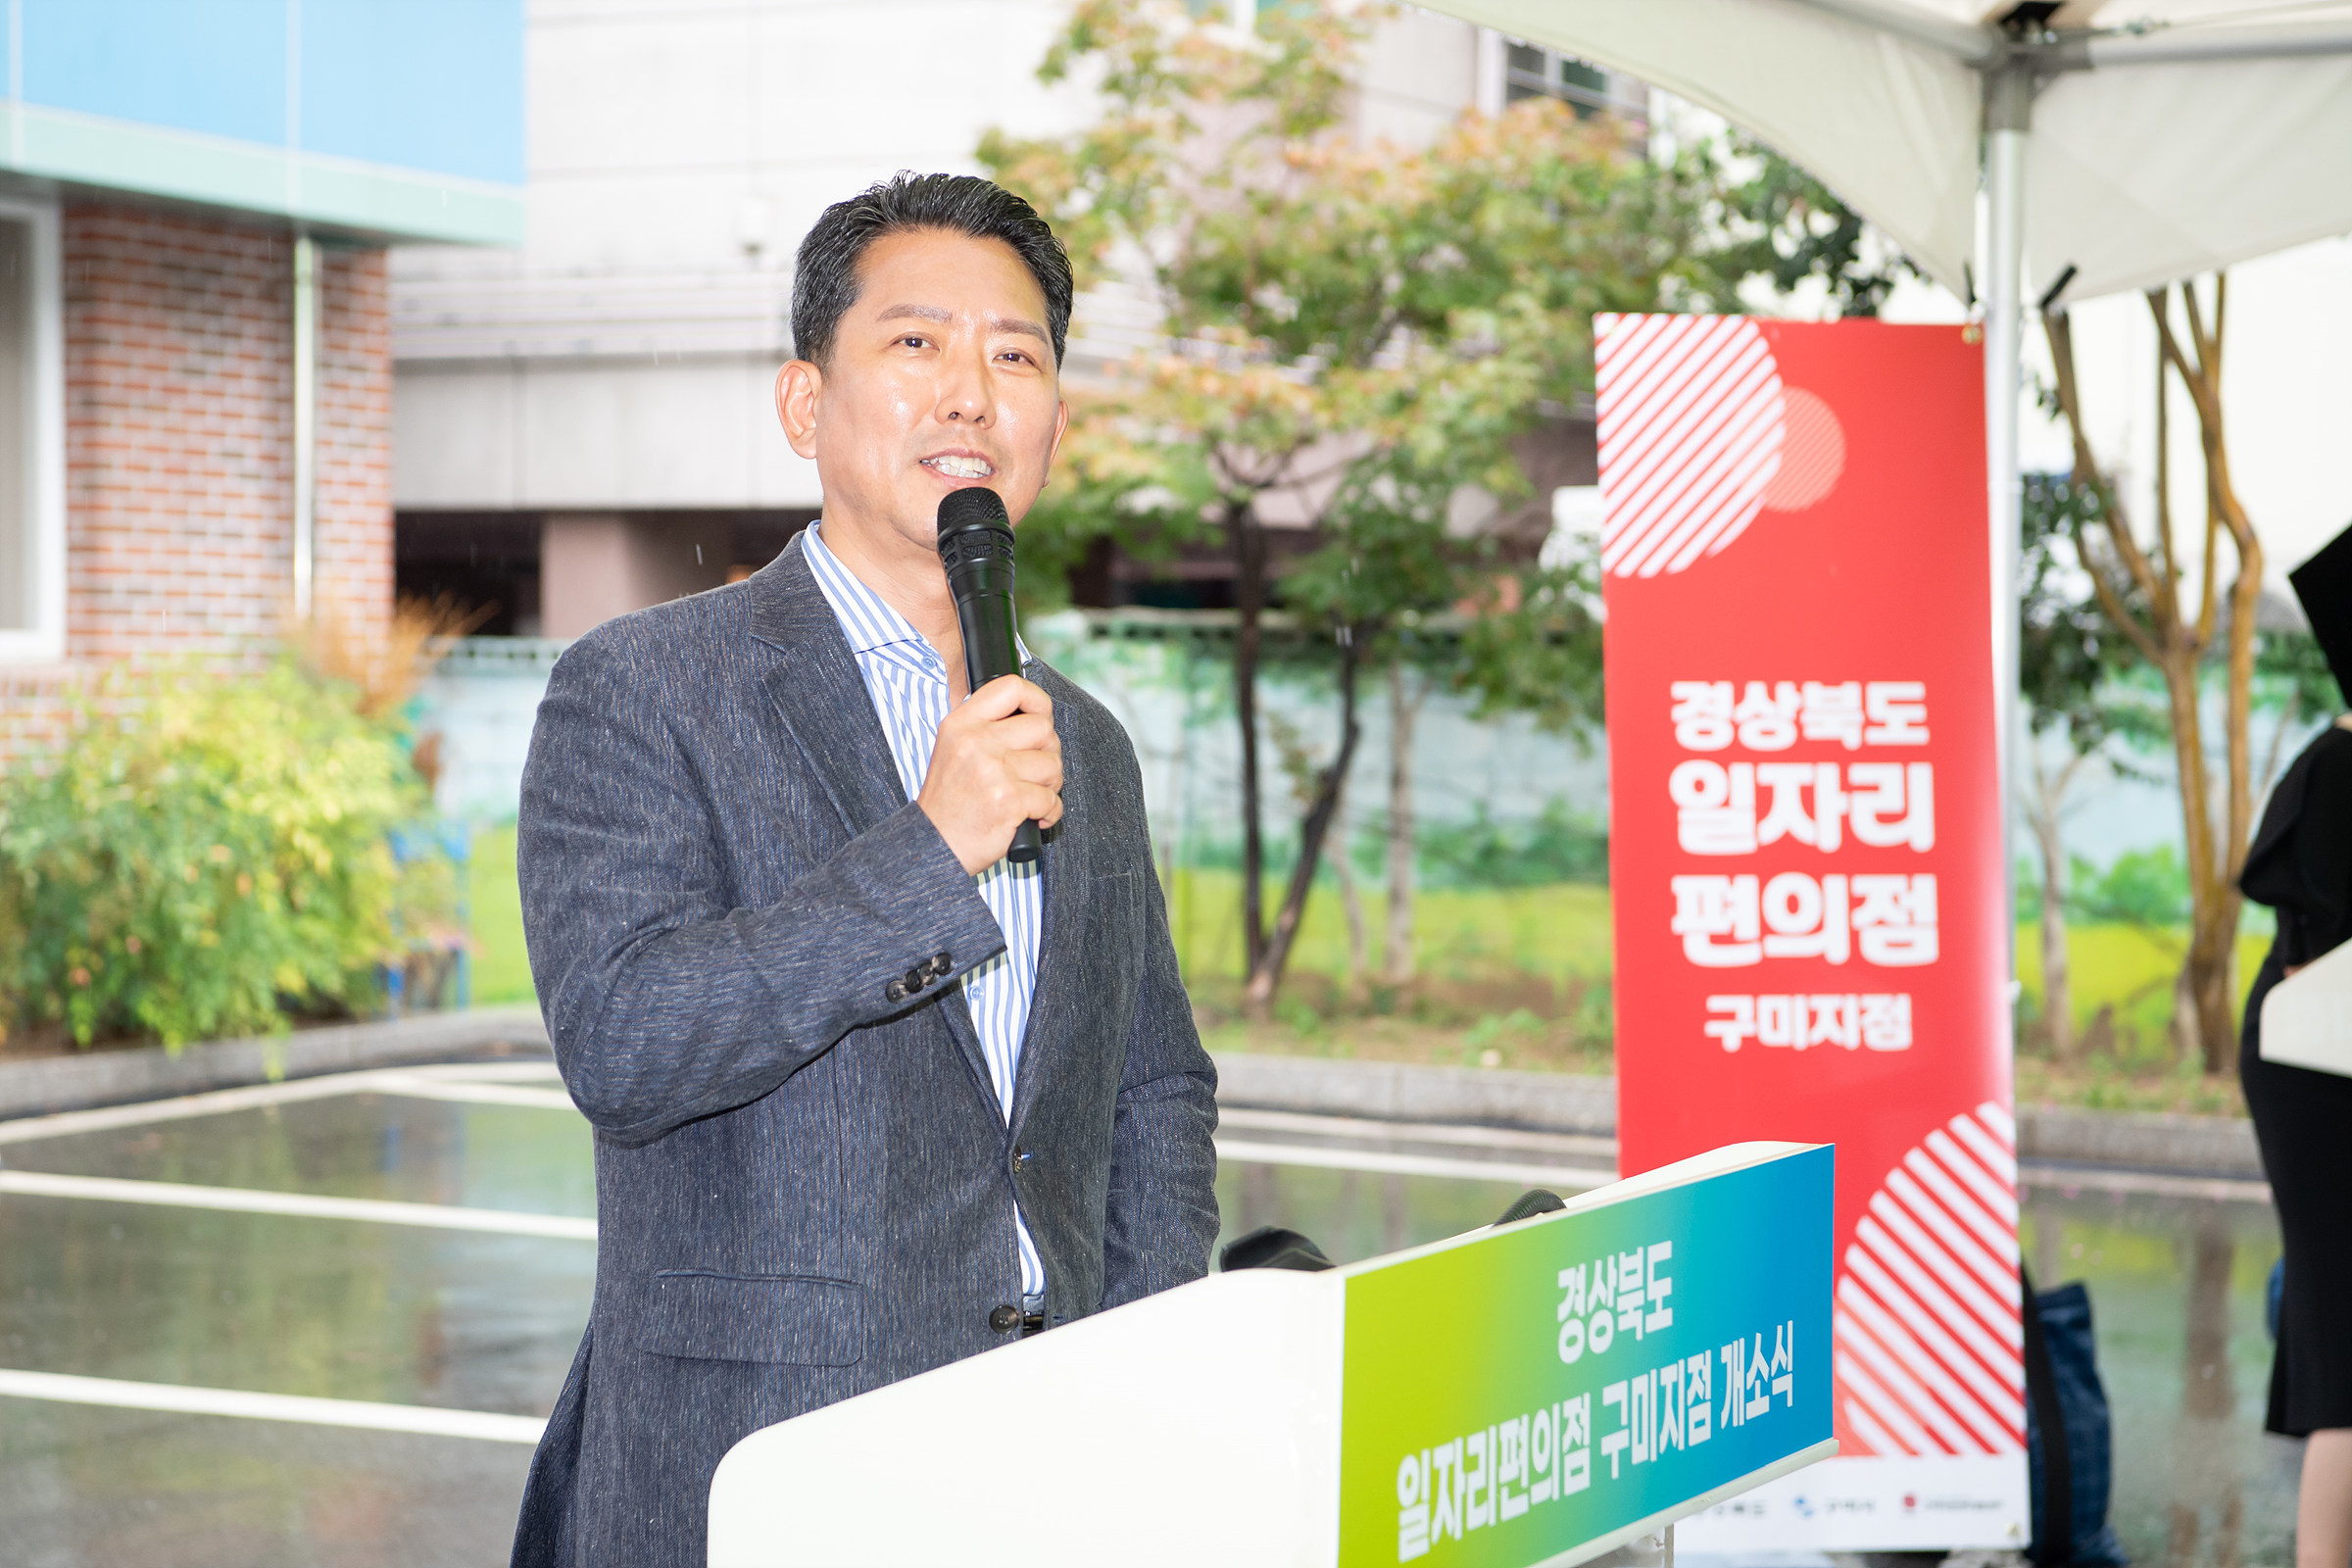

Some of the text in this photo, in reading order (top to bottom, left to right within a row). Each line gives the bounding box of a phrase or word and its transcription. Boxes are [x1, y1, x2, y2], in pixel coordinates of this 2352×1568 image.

[1671, 680, 1930, 752] 경상북도
[1669, 760, 1936, 856] 일자리
[1671, 871, 1939, 968] 편의점
[1704, 993, 1913, 1052] 구미지점
[1556, 1240, 1673, 1365] 경상북도
[1397, 1320, 1794, 1563] 일자리편의점 구미지점 개소식
